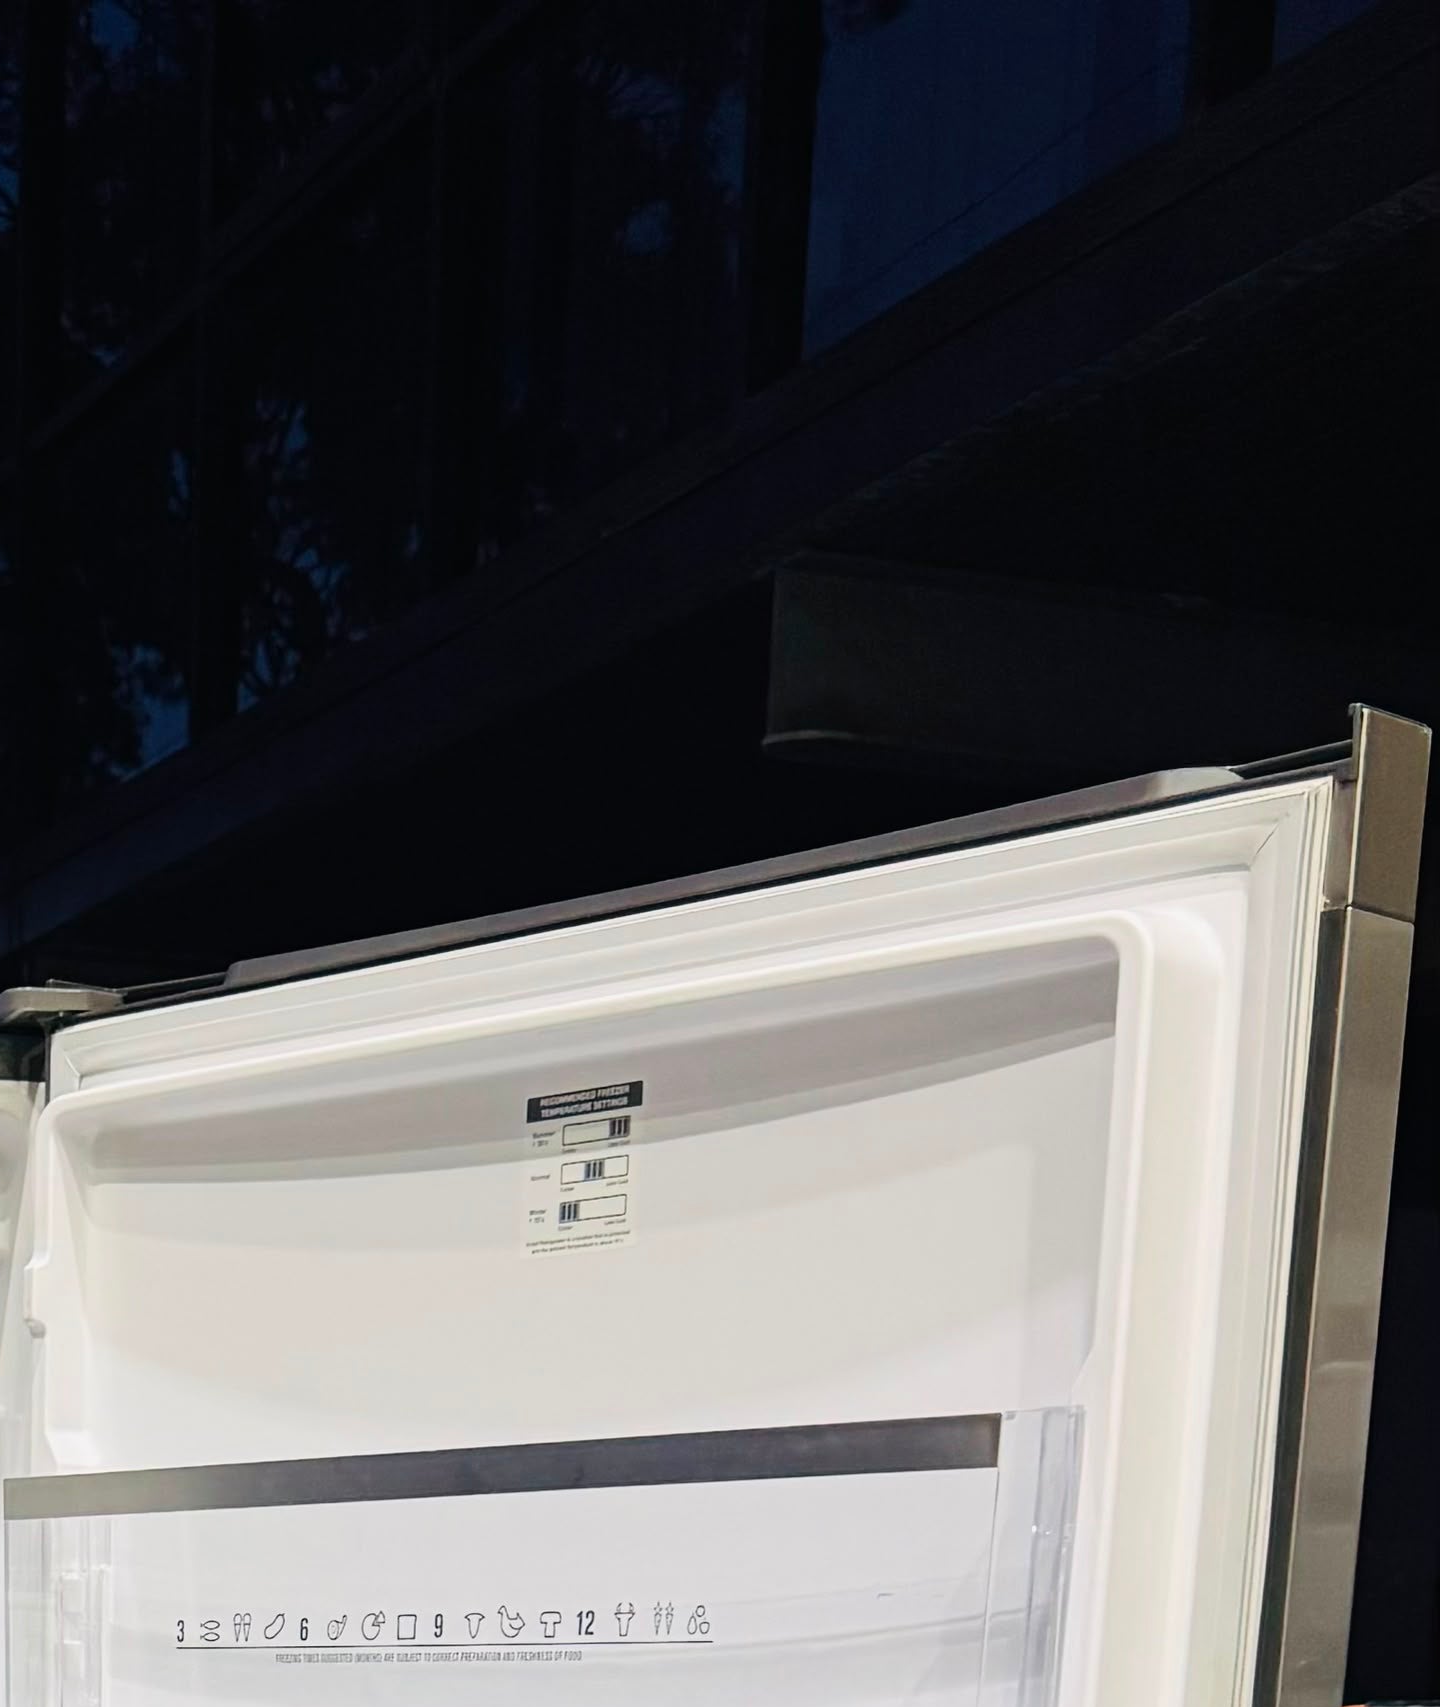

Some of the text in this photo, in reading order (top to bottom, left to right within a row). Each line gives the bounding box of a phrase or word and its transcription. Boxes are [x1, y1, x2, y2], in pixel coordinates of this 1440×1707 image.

[177, 1610, 595, 1642] 3 6 9 12
